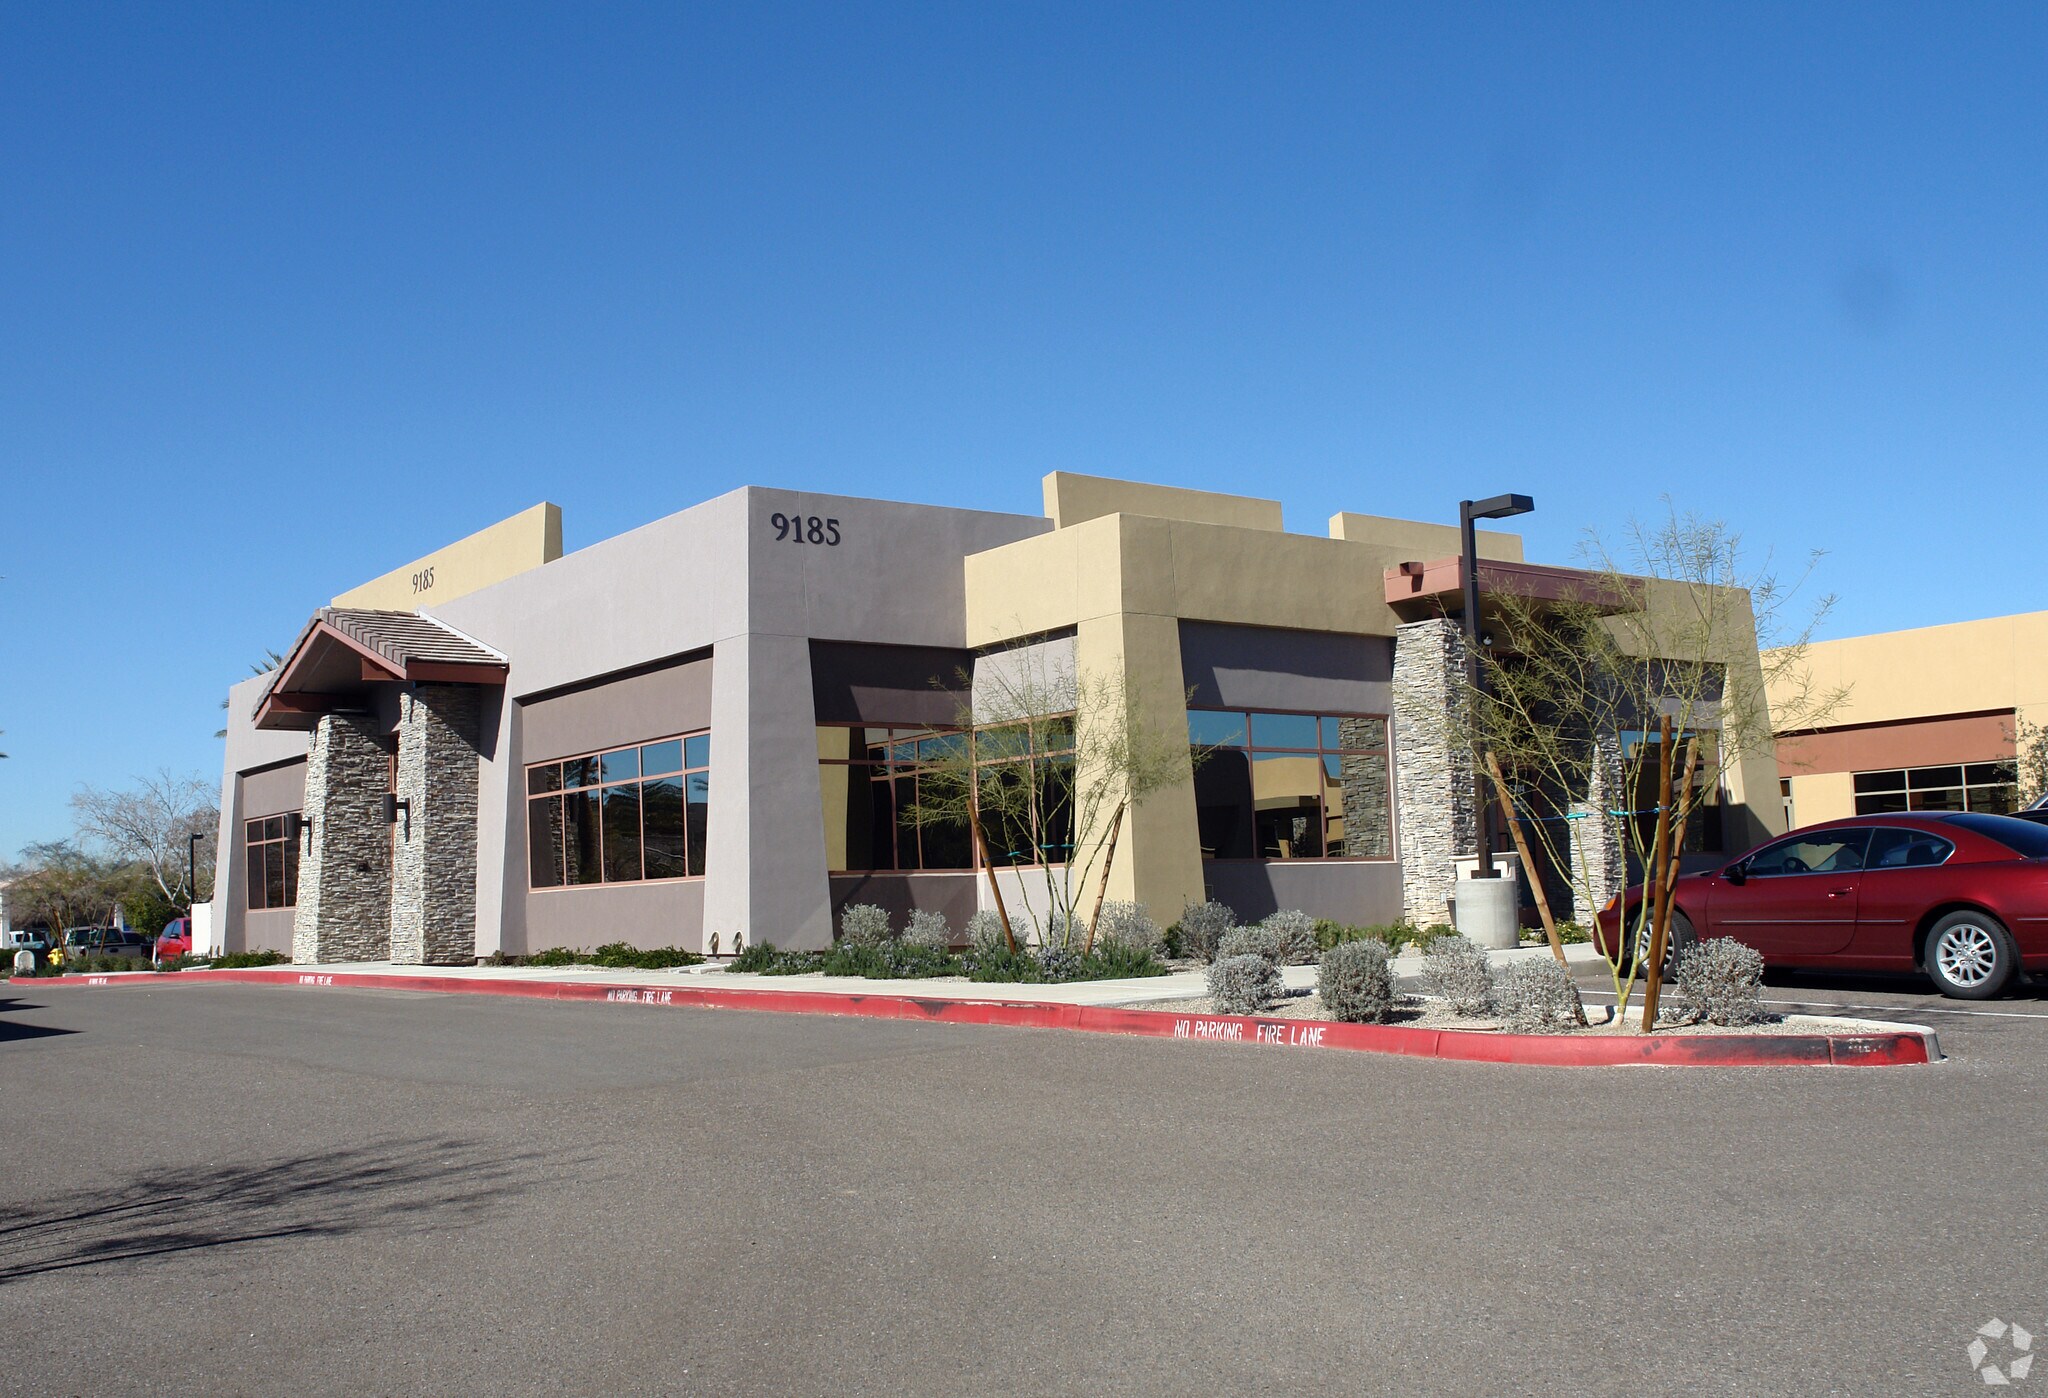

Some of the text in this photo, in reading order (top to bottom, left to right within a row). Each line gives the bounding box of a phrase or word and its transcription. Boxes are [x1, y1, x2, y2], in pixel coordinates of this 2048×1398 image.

[771, 512, 841, 547] 9185
[412, 566, 434, 595] 9185
[642, 990, 655, 1004] FIRE
[656, 991, 672, 1005] LANE
[1174, 1019, 1327, 1047] NO PARKING FIRE LANE
